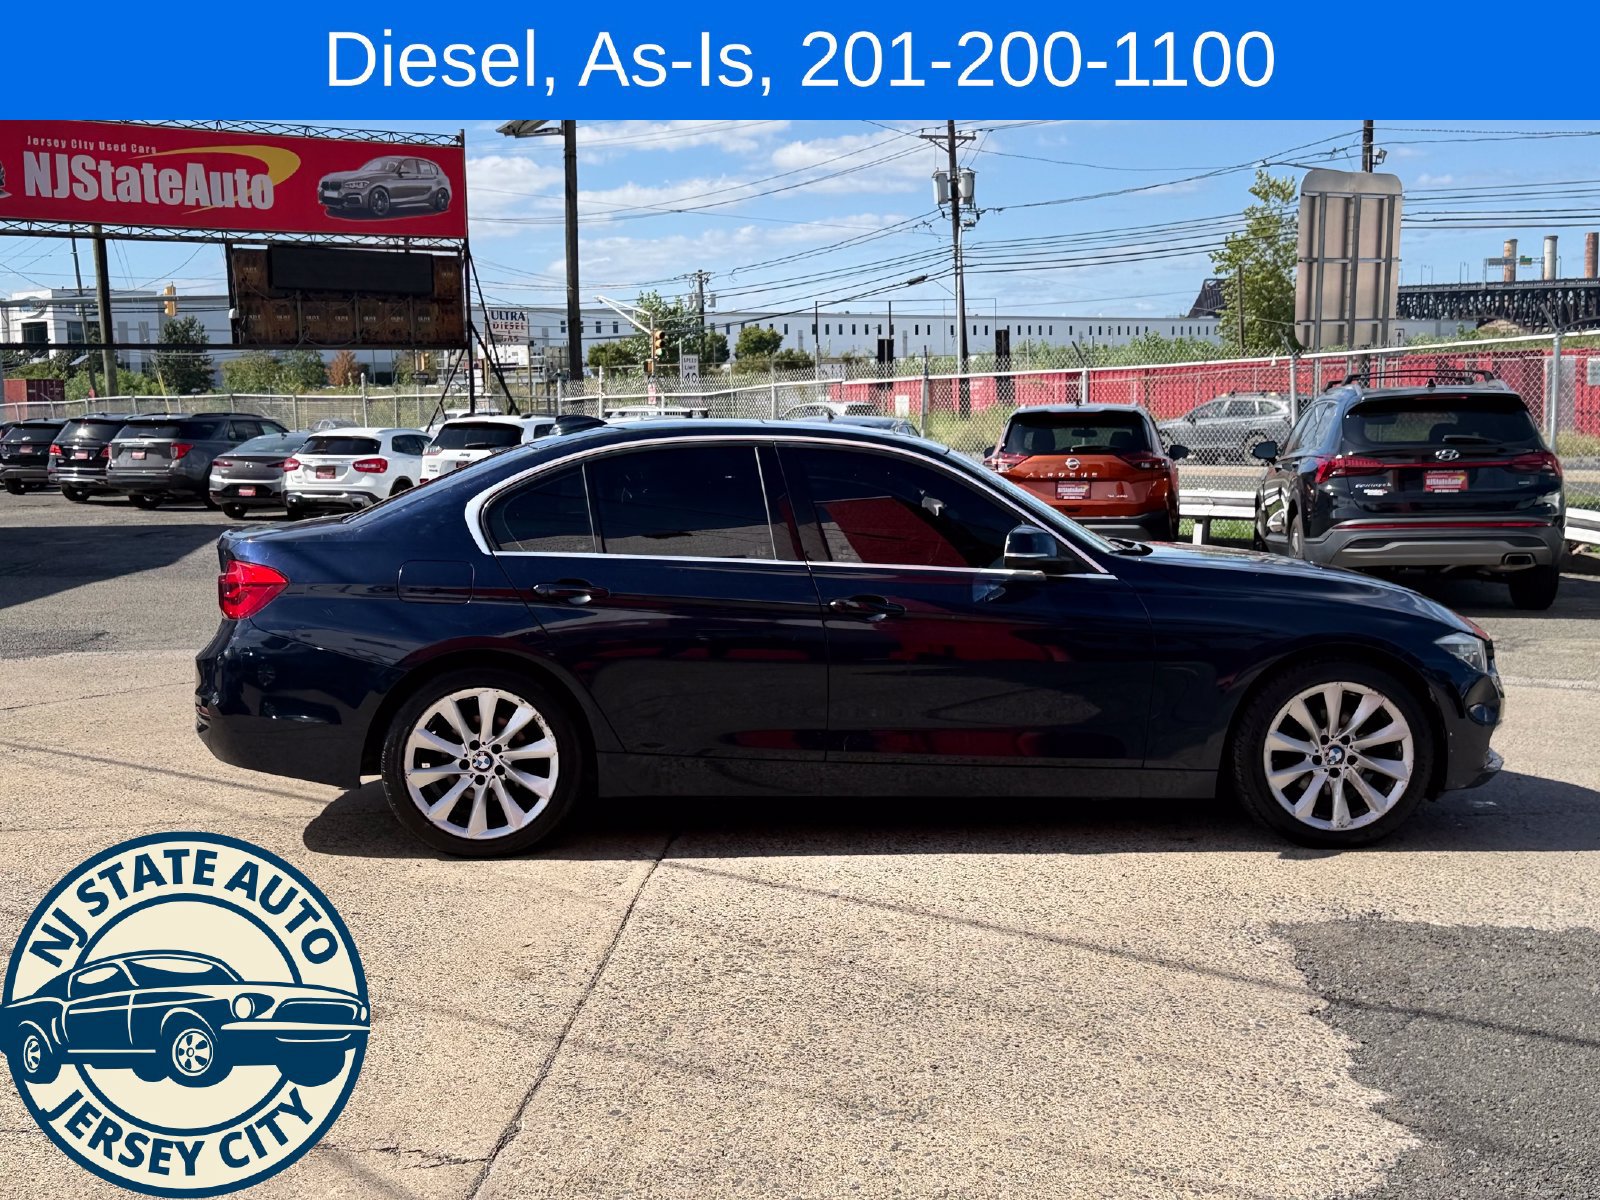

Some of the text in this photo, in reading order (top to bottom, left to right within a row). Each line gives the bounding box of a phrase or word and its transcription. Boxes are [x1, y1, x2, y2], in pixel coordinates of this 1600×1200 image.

[26, 135, 157, 154] Jersey City Used Cars
[22, 149, 275, 211] NJStateAuto
[491, 310, 526, 322] ULTRA
